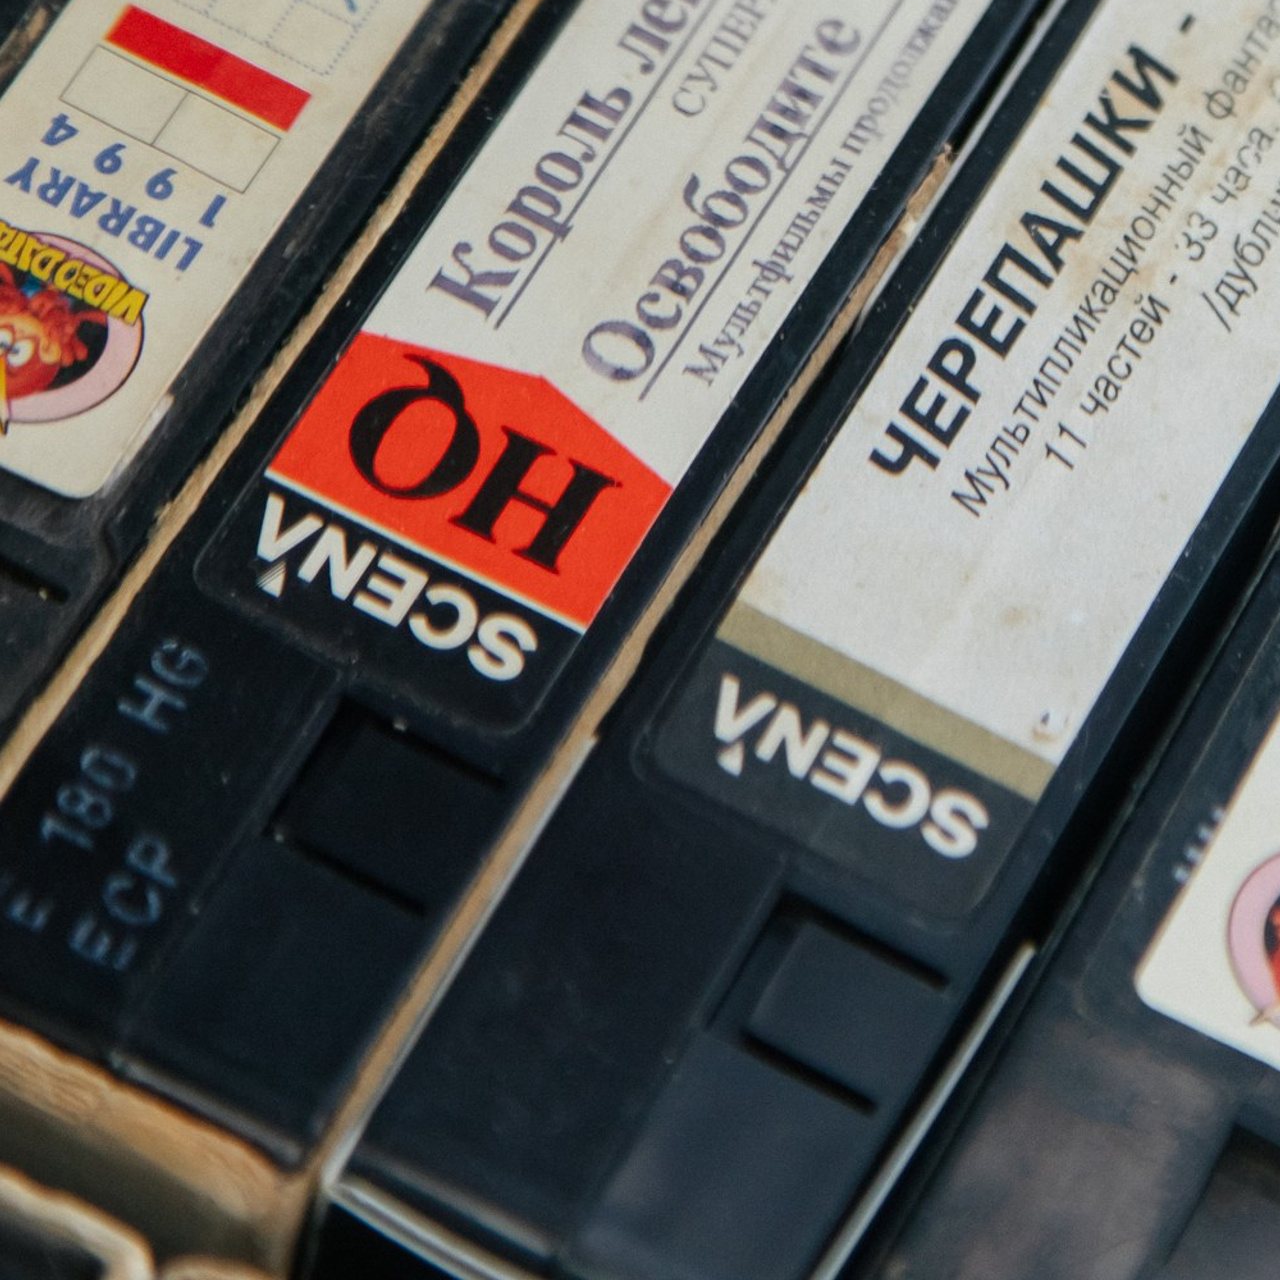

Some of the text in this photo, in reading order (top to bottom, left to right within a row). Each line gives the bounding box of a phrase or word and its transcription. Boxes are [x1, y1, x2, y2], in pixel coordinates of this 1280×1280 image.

[3, 156, 204, 273] LIBRARY
[426, 85, 633, 319] Король
[580, 18, 860, 383] Освободите
[681, 155, 853, 387] Мультфильмы
[867, 43, 1179, 476] ЧЕРЕПАШКИ
[948, 122, 1213, 518] Мультипликационный
[1042, 419, 1088, 471] 11
[1078, 292, 1171, 417] частей
[1172, 209, 1220, 264] 33
[348, 353, 624, 576] HQ
[40, 745, 136, 852] 180
[117, 634, 210, 734] HG
[67, 832, 178, 971] ECP
